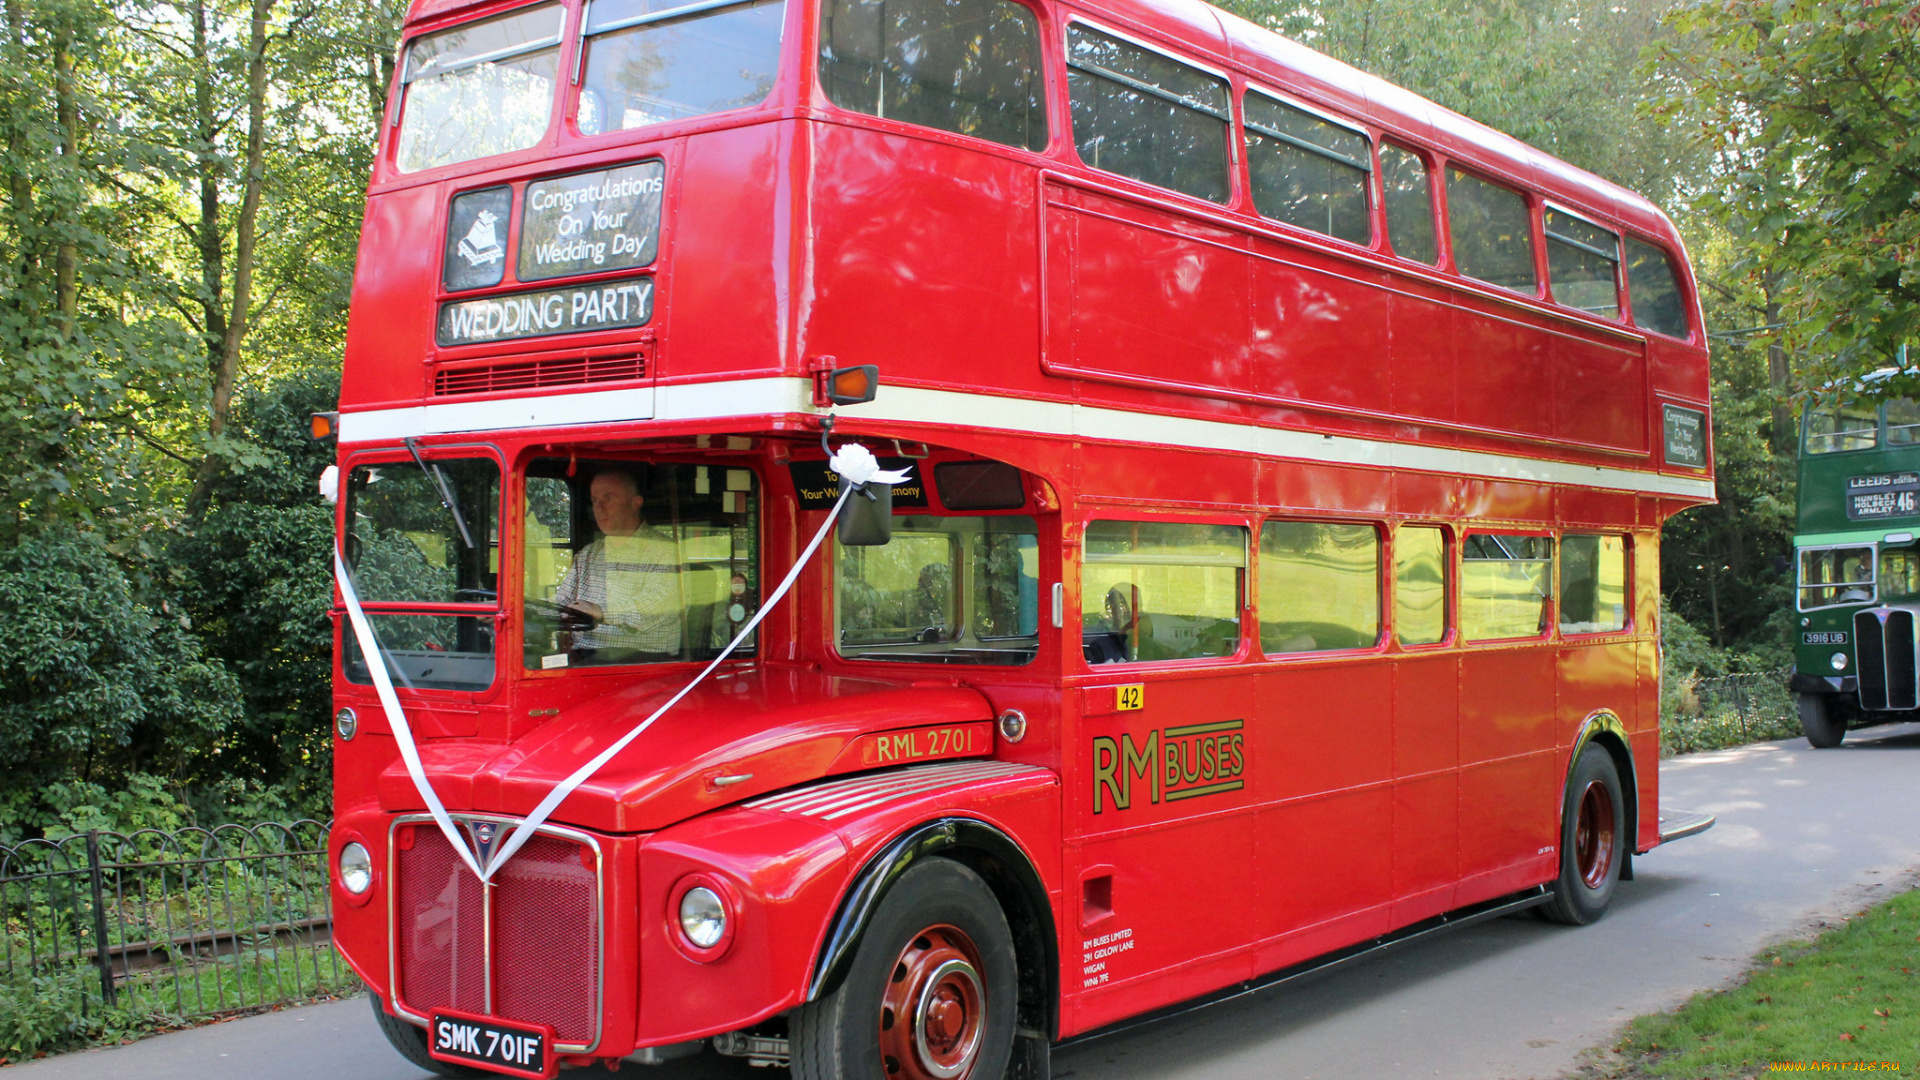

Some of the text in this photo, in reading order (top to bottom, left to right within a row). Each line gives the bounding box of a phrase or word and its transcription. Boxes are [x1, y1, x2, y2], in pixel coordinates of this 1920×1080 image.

[532, 177, 663, 212] Congratulations
[558, 209, 628, 236] On Your
[536, 233, 647, 265] Wedding Day
[450, 283, 653, 339] WEDDING PARTY
[824, 470, 838, 482] To
[1850, 476, 1891, 488] LEEDS
[800, 488, 823, 500] Your
[892, 487, 919, 498] mony
[1897, 491, 1914, 511] 46
[1806, 633, 1844, 643] 3916 UB
[1121, 688, 1139, 708] 42
[877, 729, 972, 762] RML 2701
[1093, 729, 1244, 815] RM BUSES
[1083, 928, 1132, 950] RM BUSES LIMITED
[1083, 940, 1134, 963] 291 GIDLOW LANE
[1083, 961, 1105, 975] WIGAN
[1083, 977, 1098, 988] WN6
[438, 1021, 539, 1065] SMK 701F
